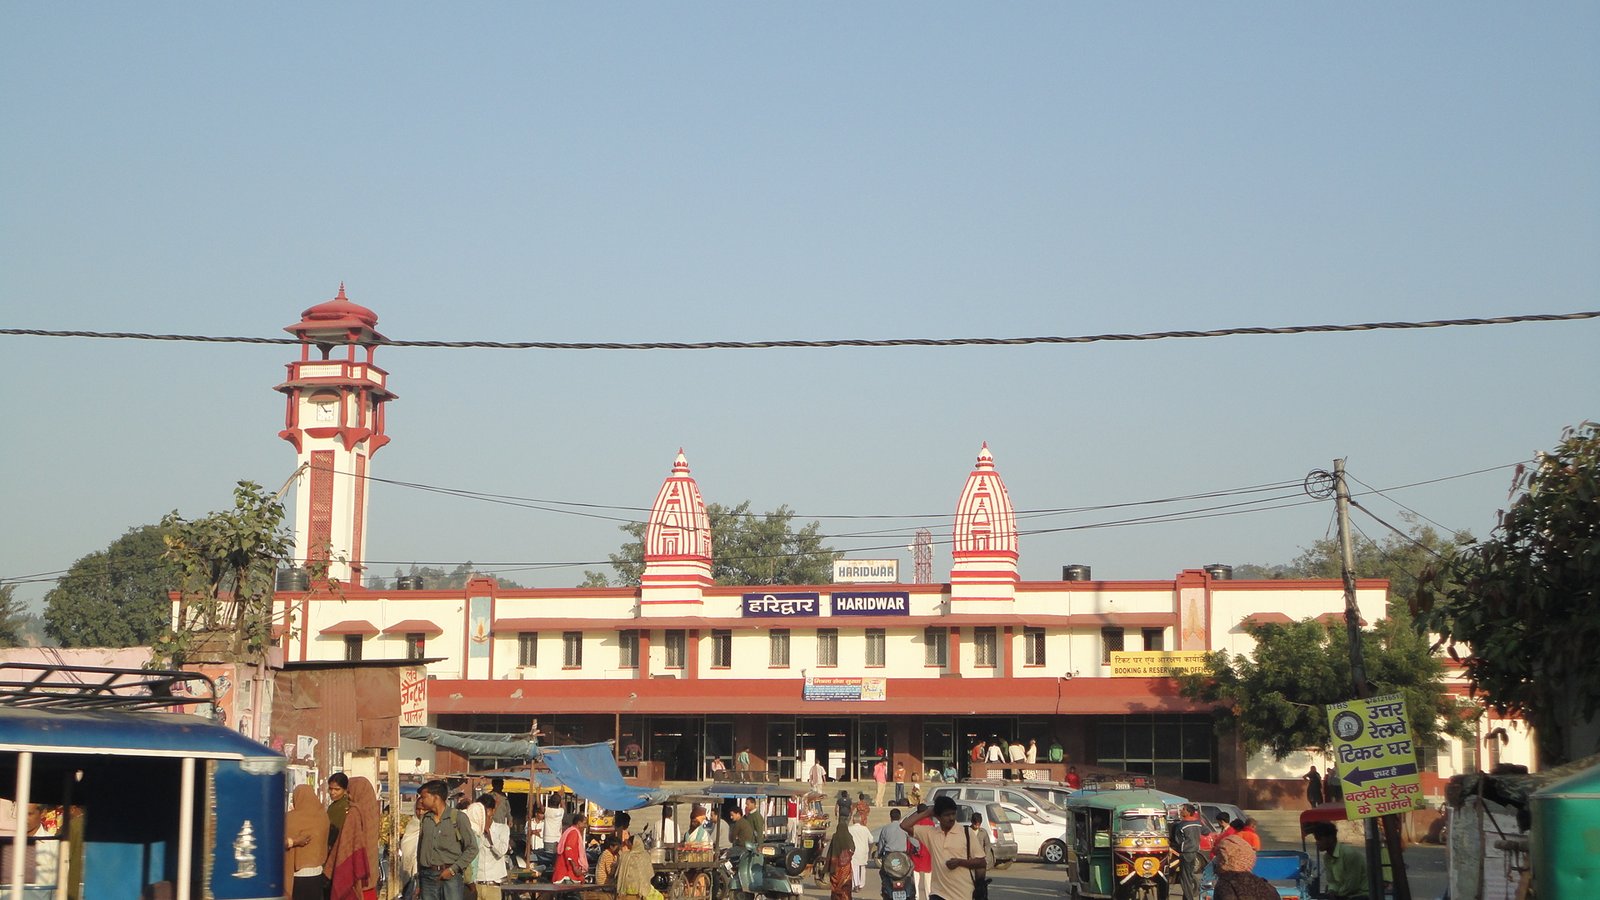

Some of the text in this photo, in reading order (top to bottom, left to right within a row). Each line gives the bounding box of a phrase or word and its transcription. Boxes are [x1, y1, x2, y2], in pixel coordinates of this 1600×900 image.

[838, 565, 894, 577] HARIDWAR
[748, 595, 815, 614] हरिद्वार
[837, 597, 905, 610] HARIDWAR
[1366, 702, 1404, 720] उत्तर
[1367, 717, 1407, 739] रेलवे
[1337, 740, 1412, 764] टिकट घर
[1357, 796, 1412, 815] के सामने
